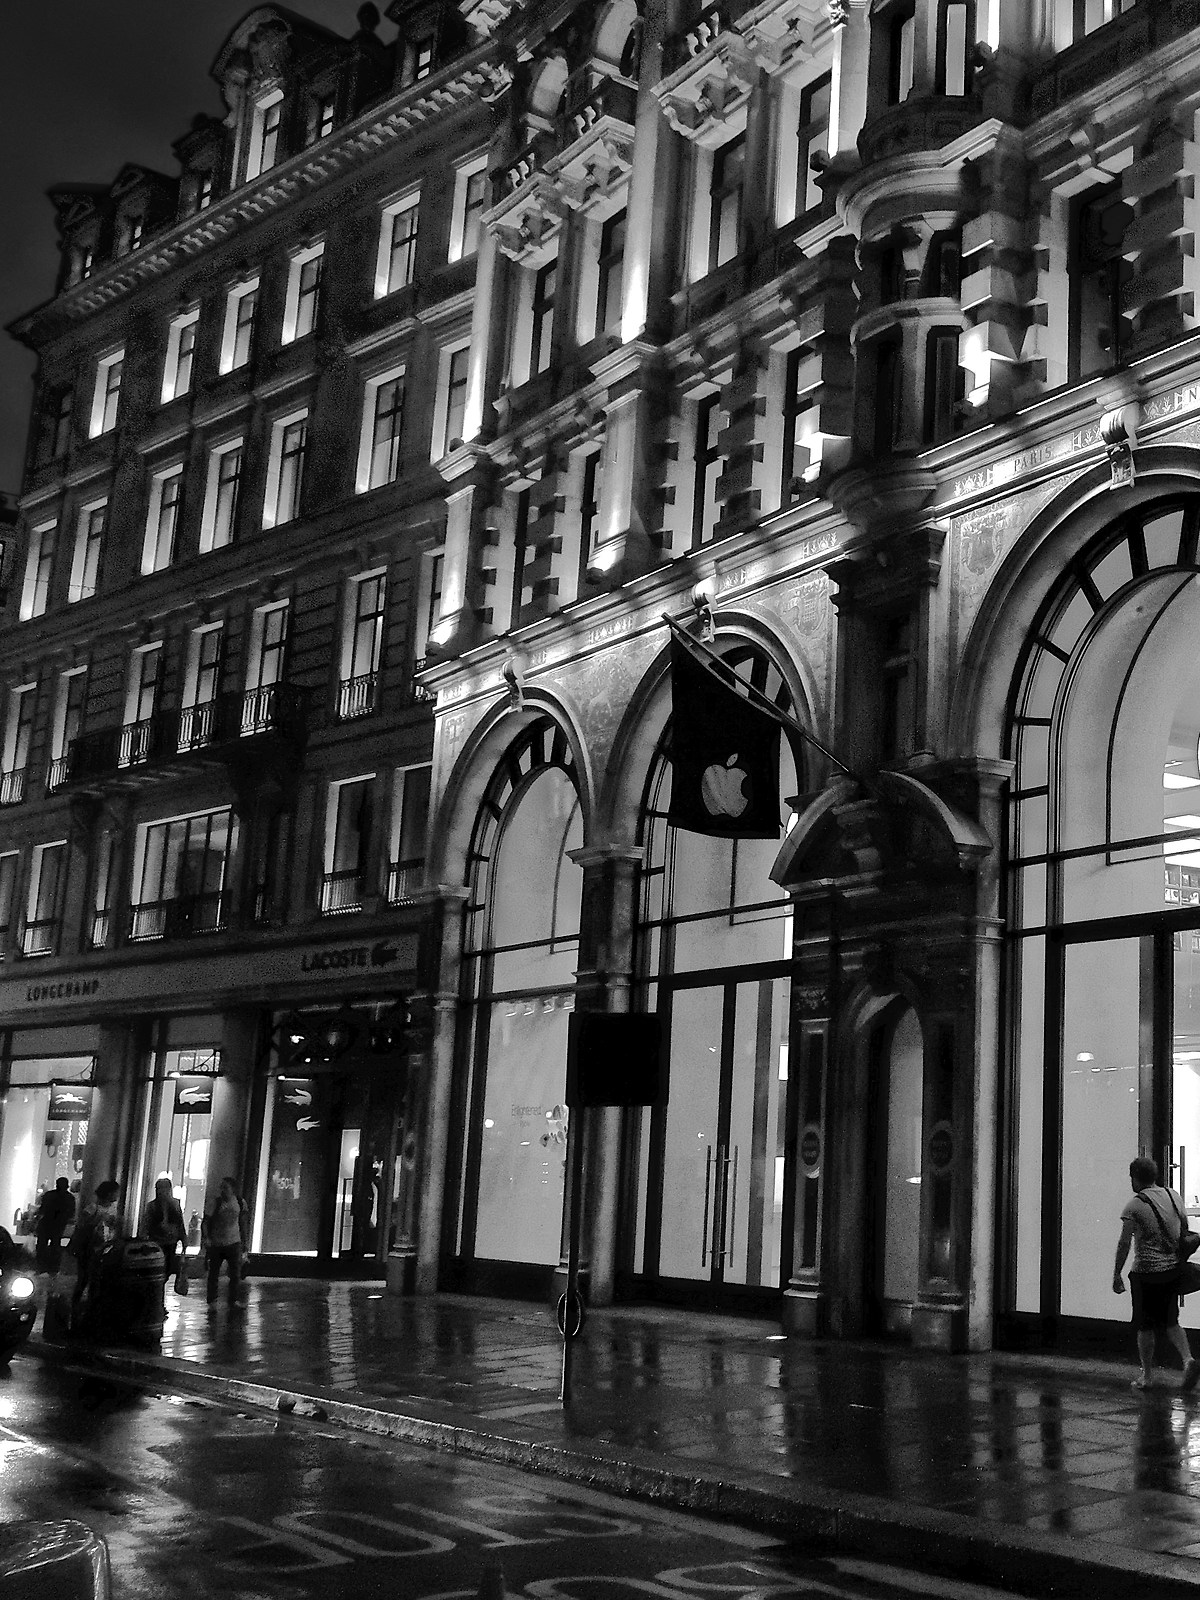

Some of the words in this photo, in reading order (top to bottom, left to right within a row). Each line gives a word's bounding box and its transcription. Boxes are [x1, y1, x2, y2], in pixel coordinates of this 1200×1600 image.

[1013, 447, 1052, 473] PARIS
[301, 947, 369, 972] LACOSTE
[26, 980, 99, 1001] LONGCHAMP
